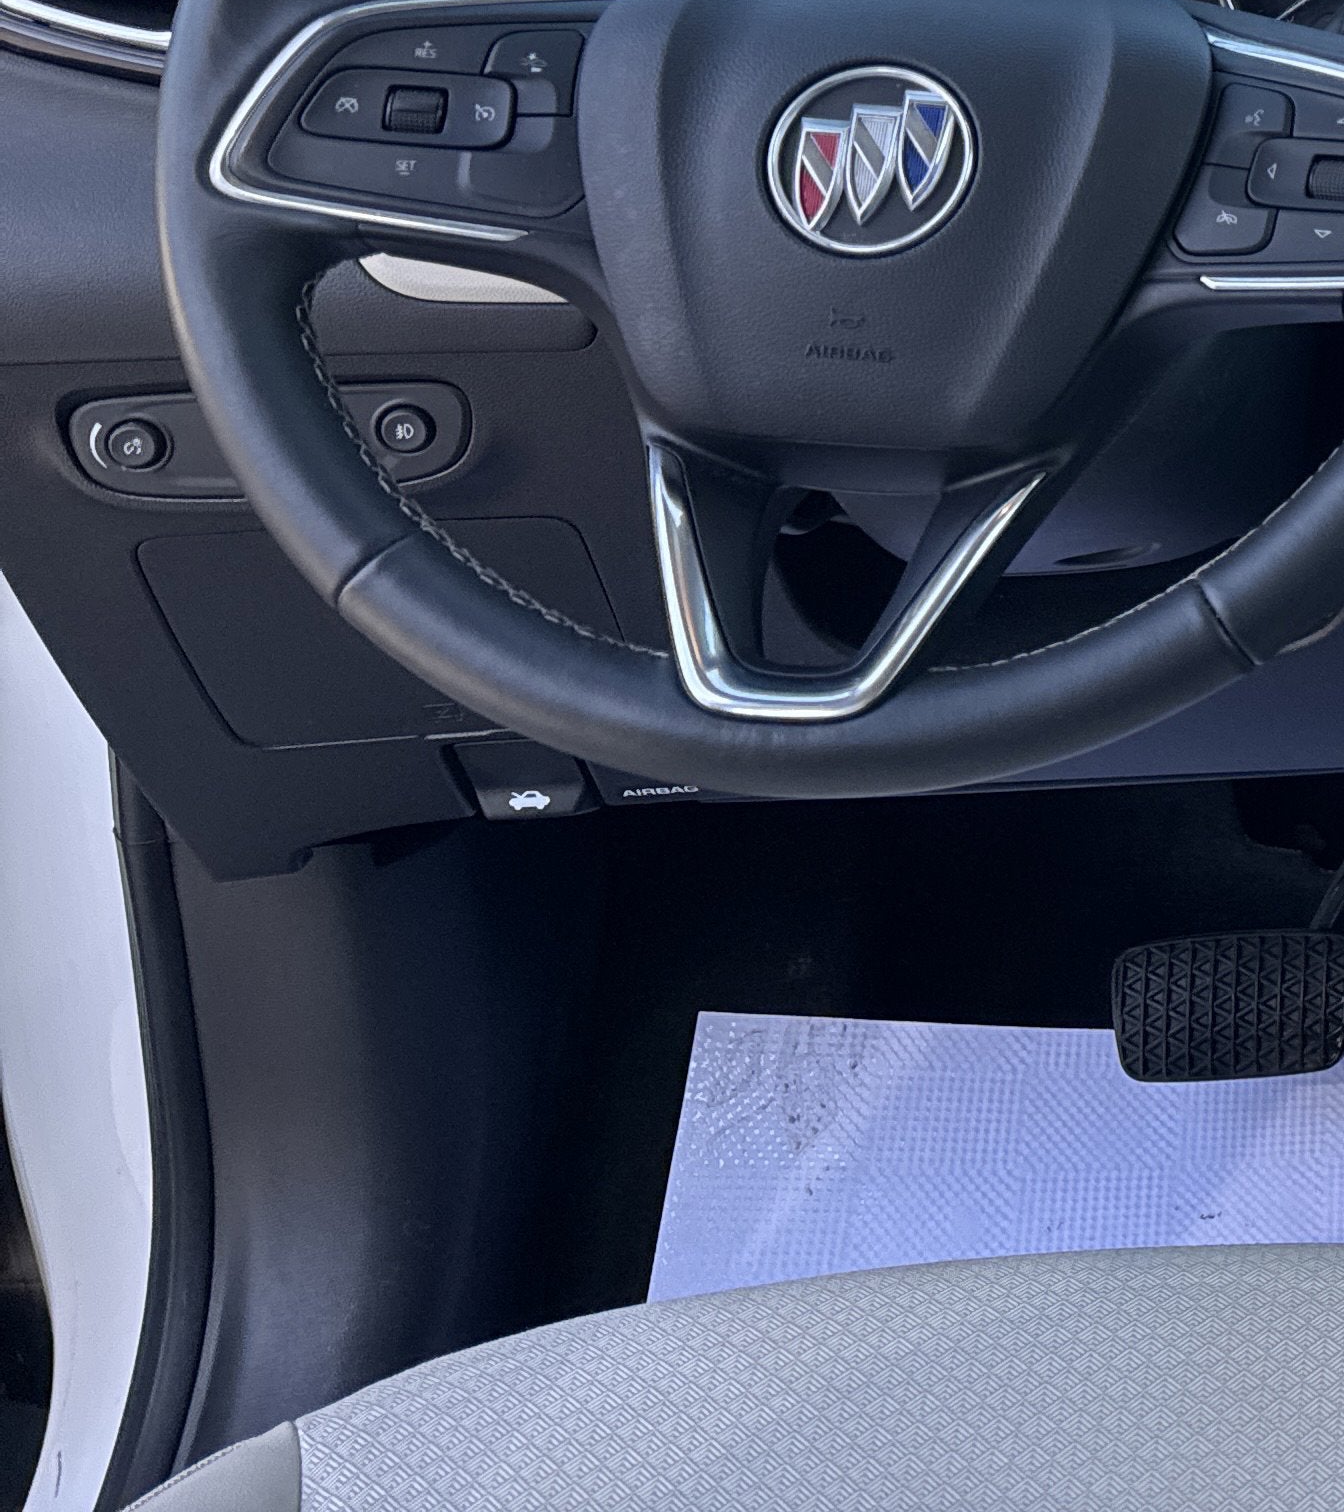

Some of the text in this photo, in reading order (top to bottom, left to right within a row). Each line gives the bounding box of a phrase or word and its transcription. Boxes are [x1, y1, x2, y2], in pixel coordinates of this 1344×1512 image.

[414, 47, 438, 59] RES
[395, 159, 417, 172] SET
[622, 785, 699, 798] AIRBAG
